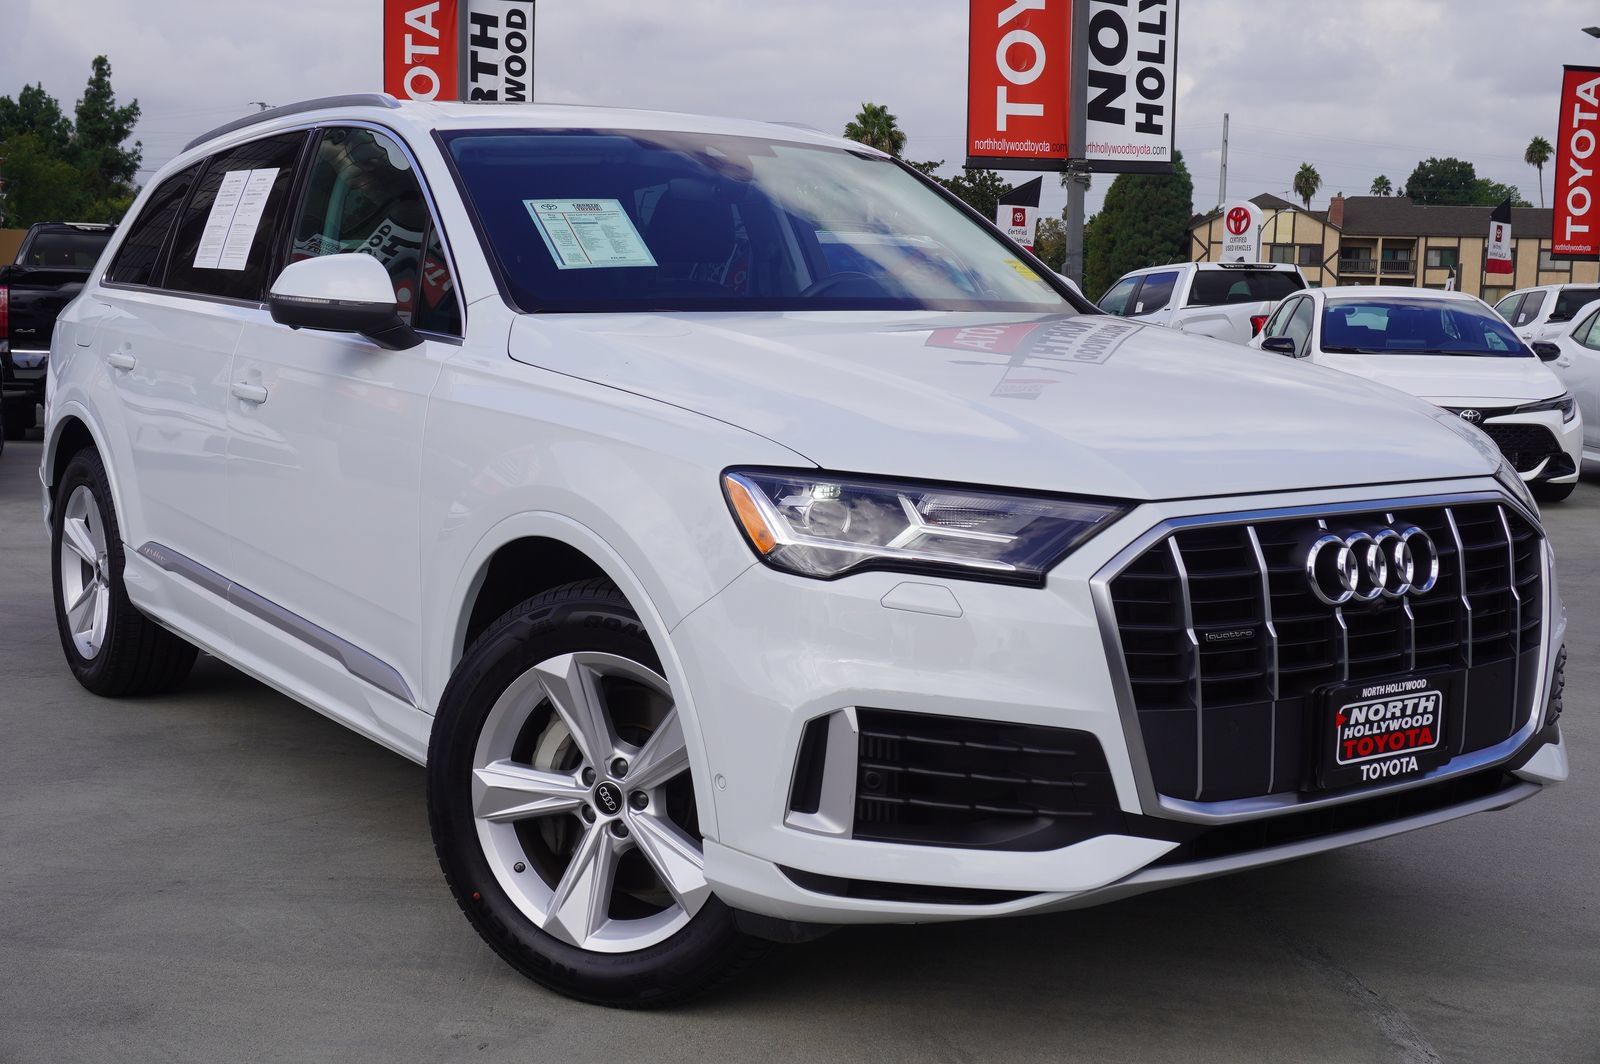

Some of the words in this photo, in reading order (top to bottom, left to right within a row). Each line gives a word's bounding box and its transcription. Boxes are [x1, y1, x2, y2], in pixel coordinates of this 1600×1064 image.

[1087, 0, 1128, 125] NO
[1565, 76, 1600, 241] TOYOTA
[1208, 630, 1253, 640] quattro
[1362, 685, 1385, 698] NORTH
[1385, 679, 1427, 694] HOLLYWOOD
[1349, 695, 1436, 725] NORTH
[1343, 714, 1433, 739] HOLLYWOOD
[1344, 727, 1433, 758] TOYOTA
[1361, 756, 1419, 781] TOYOTA
